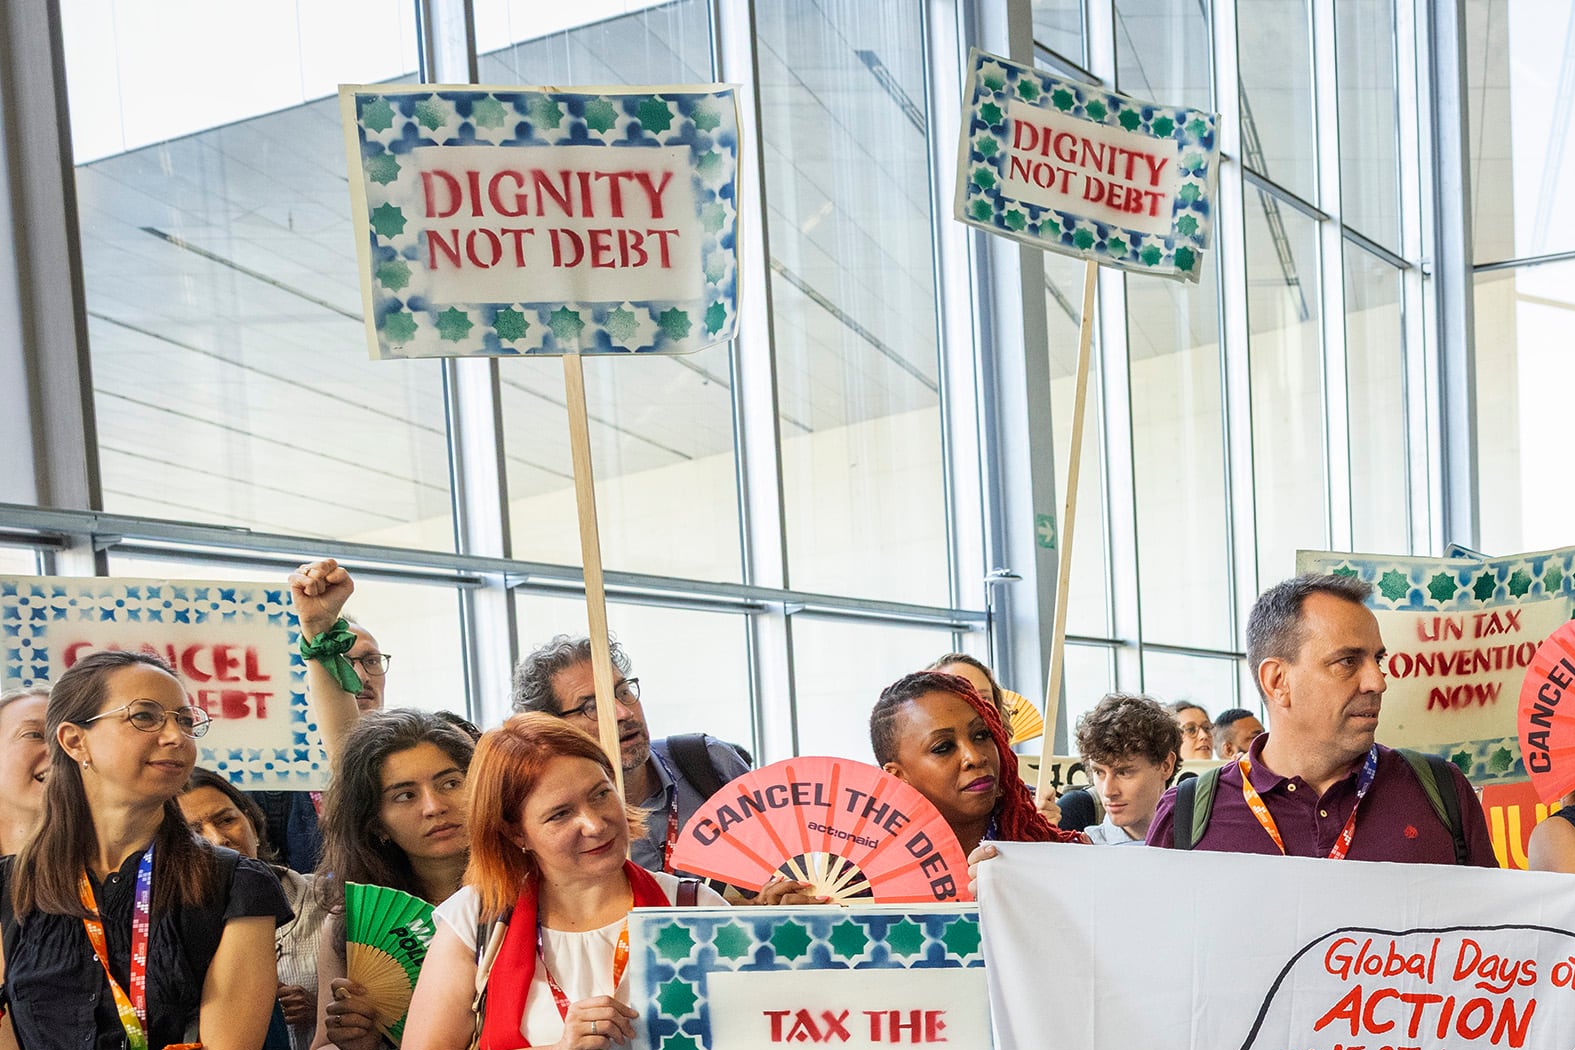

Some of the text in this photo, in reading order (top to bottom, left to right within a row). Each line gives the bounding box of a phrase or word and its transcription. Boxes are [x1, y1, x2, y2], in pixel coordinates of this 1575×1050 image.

[1012, 119, 1169, 187] DIGNITY
[420, 169, 674, 219] DIGNITY
[1008, 154, 1166, 218] NOT DEBT
[425, 228, 681, 270] NOT DEBT
[1416, 608, 1522, 642] UN TAX
[1380, 639, 1544, 680] ONVENTIO
[1426, 681, 1503, 712] NOW
[691, 781, 961, 903] CANCEL THE DEB
[1323, 937, 1441, 984] Global
[1452, 938, 1538, 995] Days
[762, 1008, 949, 1044] TAX THE
[1313, 983, 1538, 1049] ACTION
